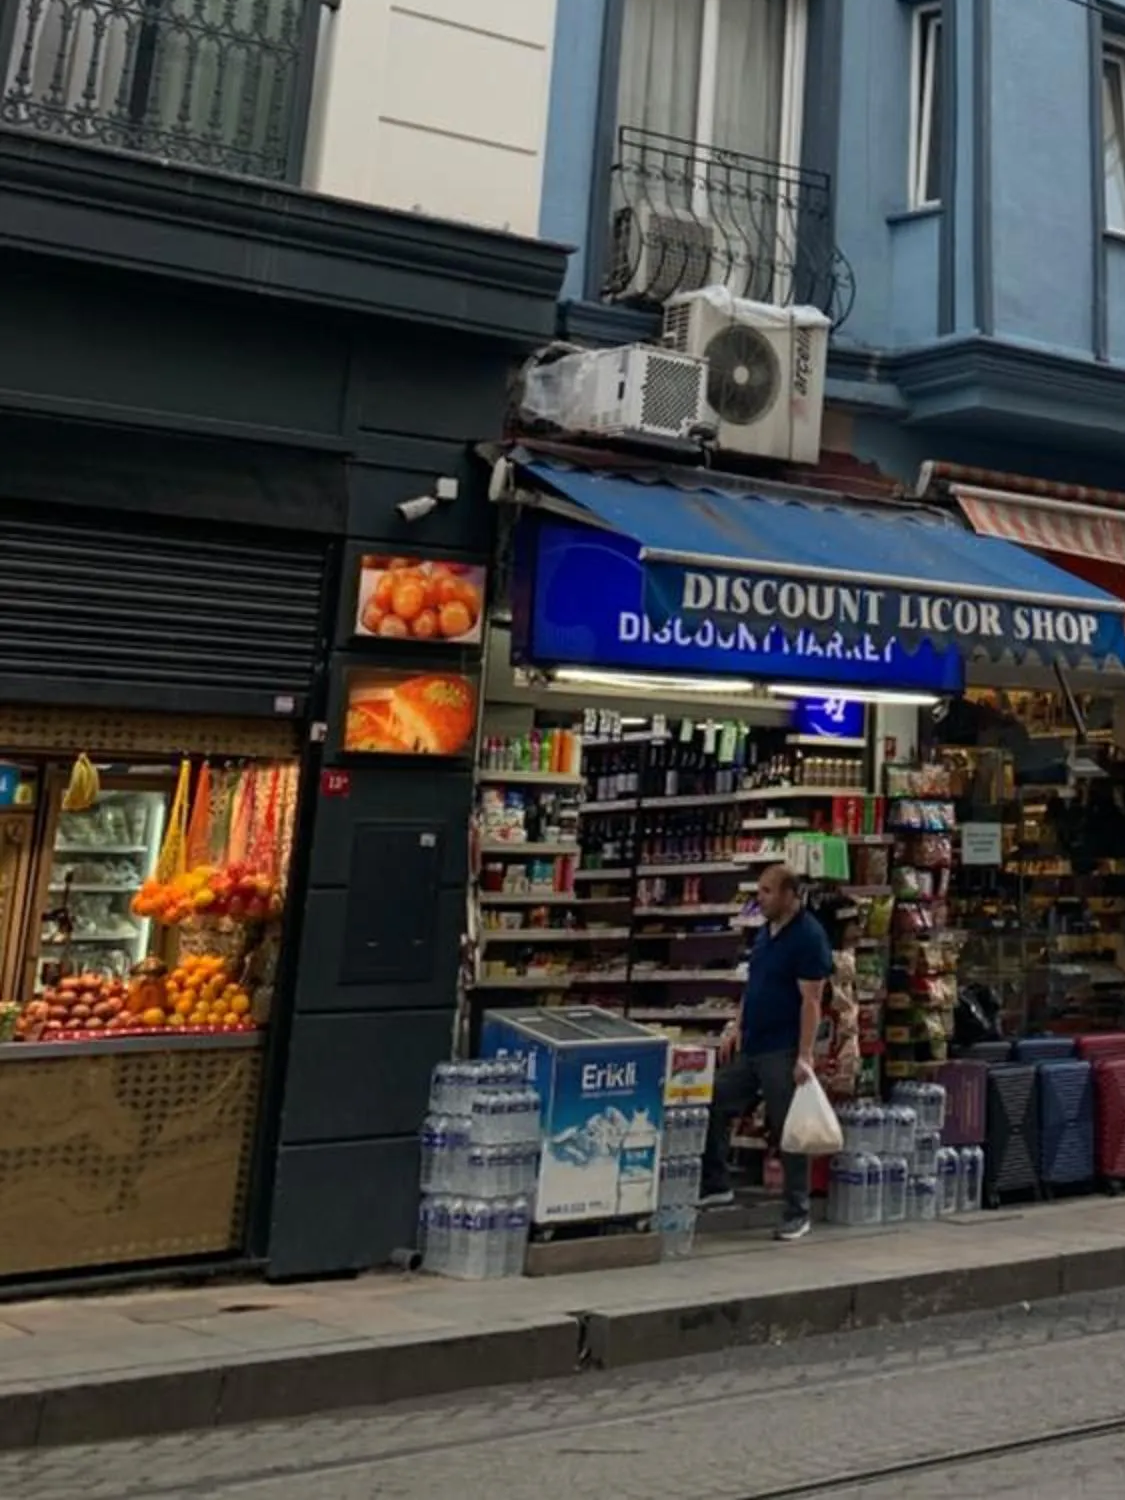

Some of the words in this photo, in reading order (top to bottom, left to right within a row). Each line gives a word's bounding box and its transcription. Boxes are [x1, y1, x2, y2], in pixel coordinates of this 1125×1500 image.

[682, 572, 886, 625] DISCOUNT
[899, 595, 1003, 637] LICOR
[1013, 607, 1098, 645] SHOP
[582, 1062, 637, 1090] Erikli
